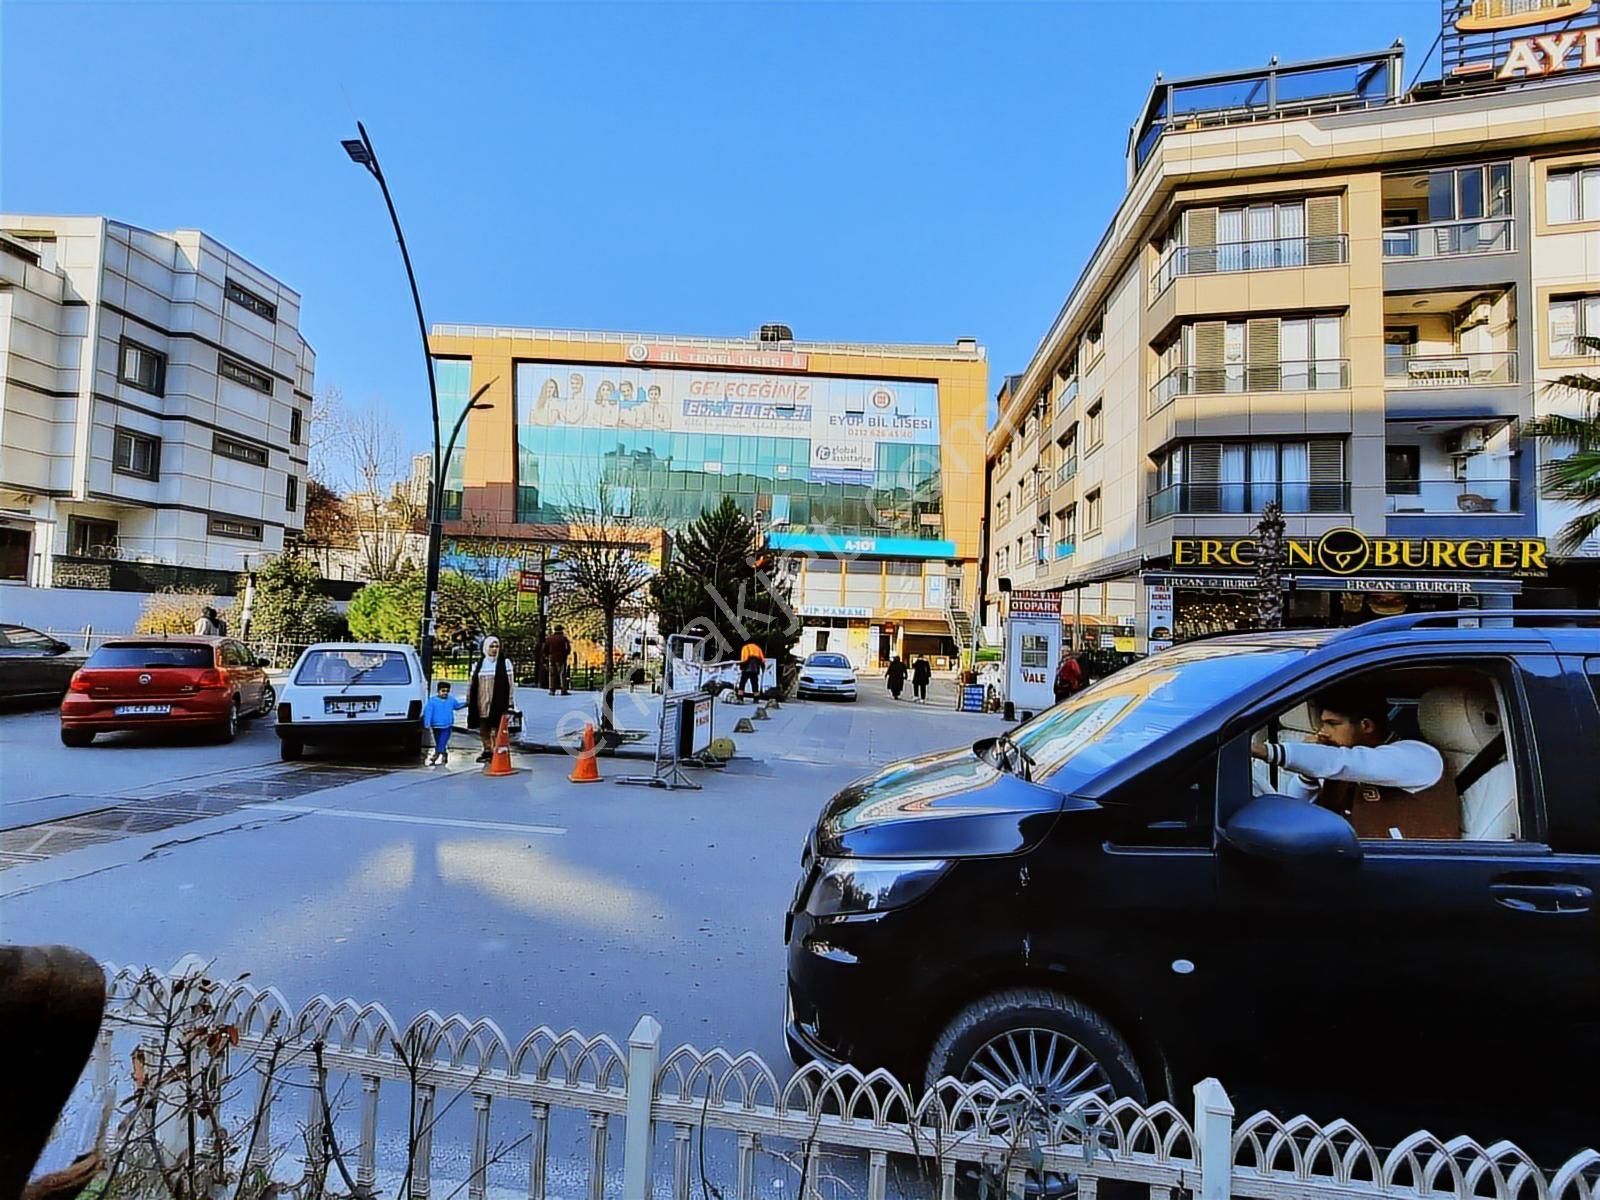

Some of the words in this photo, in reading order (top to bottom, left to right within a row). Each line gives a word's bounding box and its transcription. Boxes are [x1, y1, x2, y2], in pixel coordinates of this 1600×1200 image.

[1175, 540, 1313, 566] ERCN
[1373, 540, 1548, 569] BURGER
[1164, 577, 1204, 587] ERCAN
[1346, 580, 1396, 591] ERCAN
[1415, 581, 1472, 592] BURGER
[1011, 600, 1059, 612] OTOPARK
[1023, 671, 1047, 683] VALE
